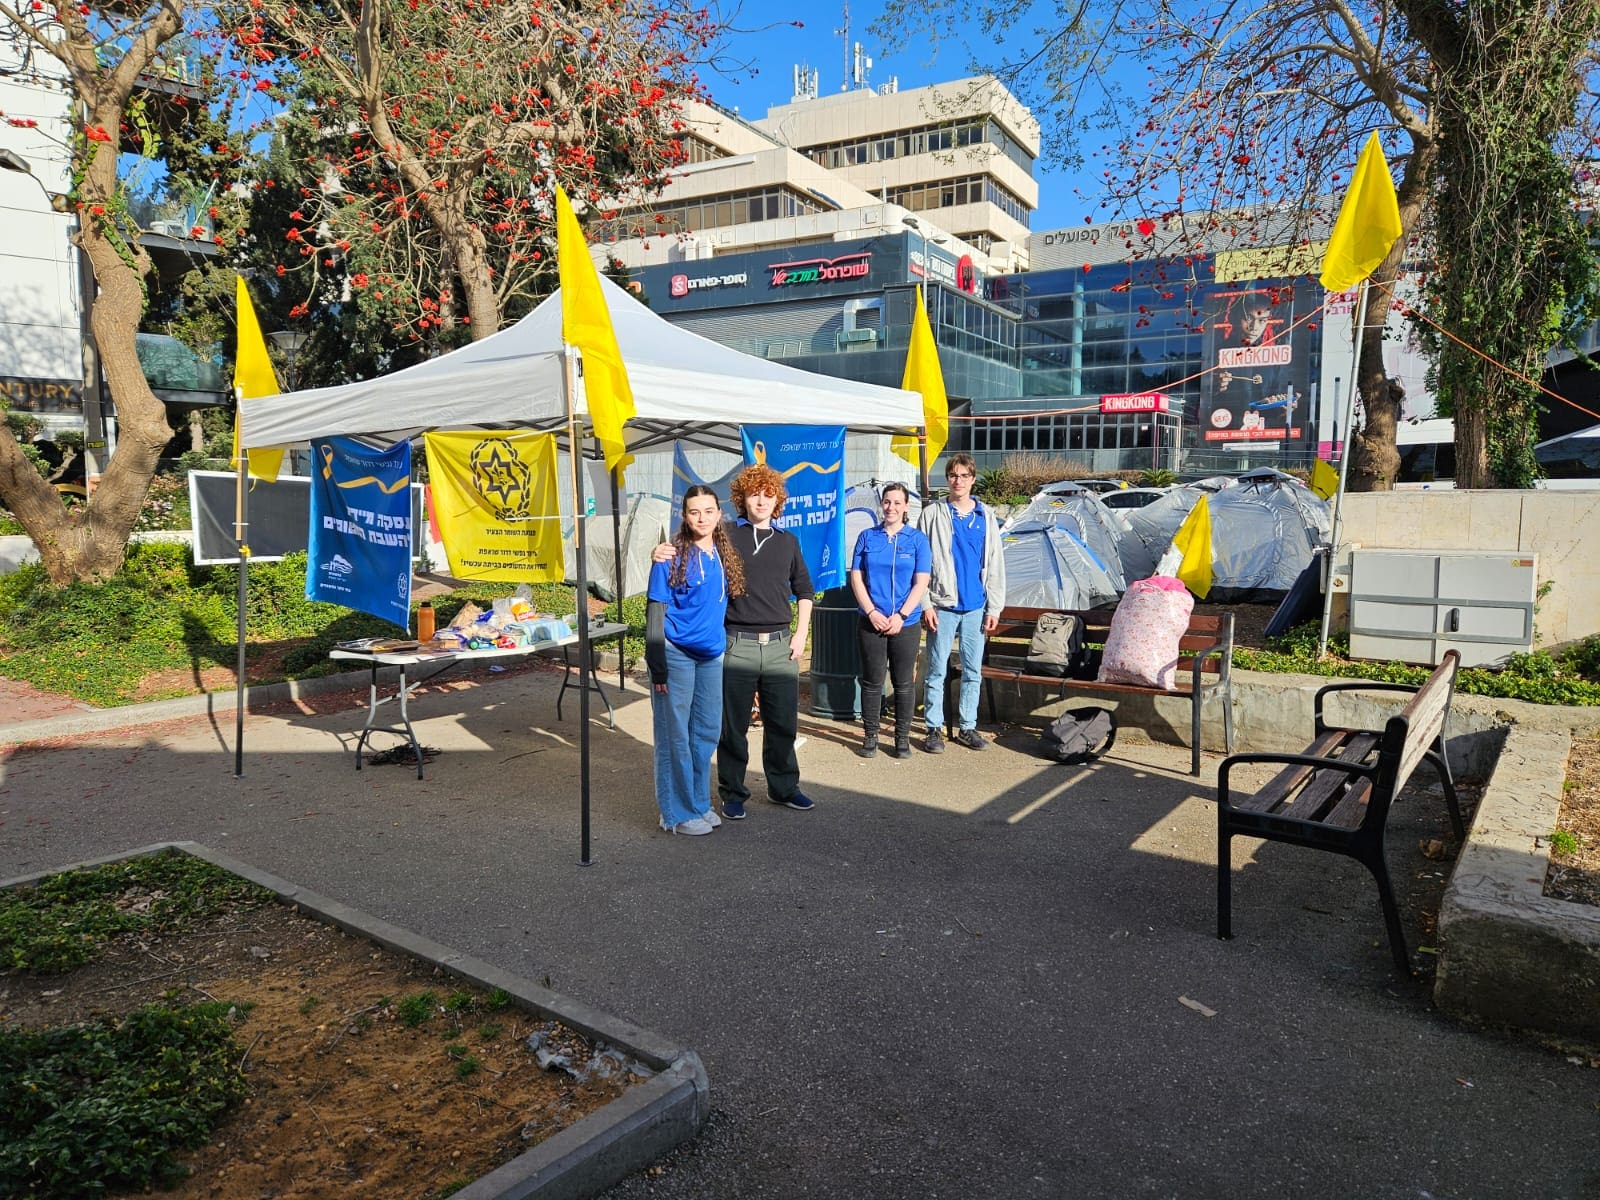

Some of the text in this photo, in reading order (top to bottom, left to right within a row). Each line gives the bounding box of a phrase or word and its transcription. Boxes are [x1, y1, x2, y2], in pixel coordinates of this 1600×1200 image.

[1045, 229, 1100, 246] הפועלים
[688, 272, 748, 289] סופר-פארם
[1220, 346, 1290, 366] KINGKONG
[1105, 396, 1155, 410] KINGKONG
